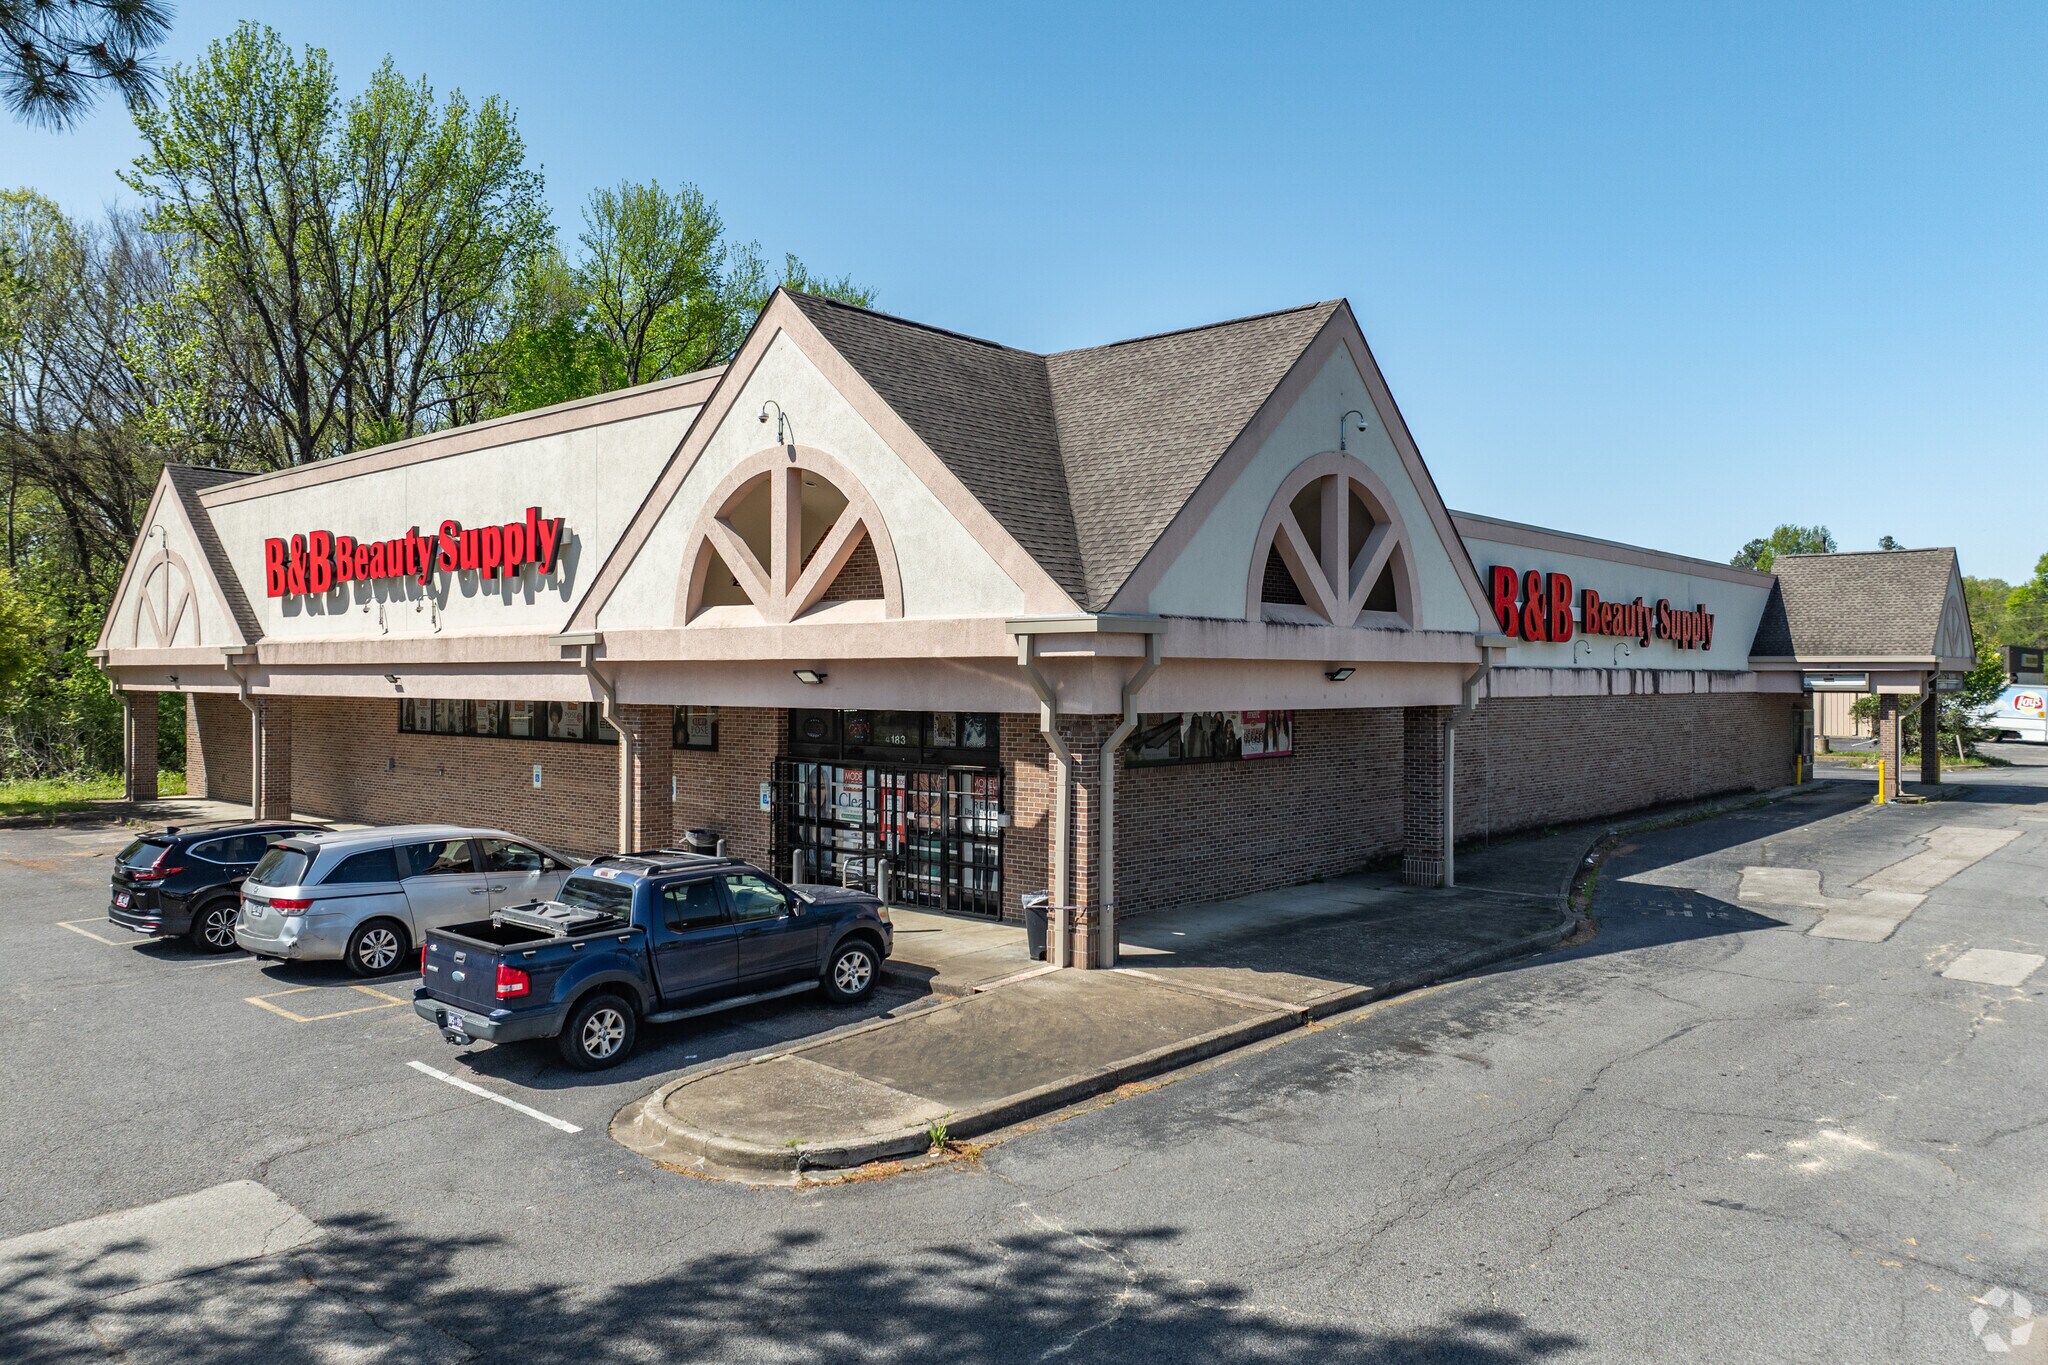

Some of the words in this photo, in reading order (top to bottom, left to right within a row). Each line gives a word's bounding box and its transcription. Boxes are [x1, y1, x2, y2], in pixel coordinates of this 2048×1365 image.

[265, 530, 337, 598] B&B
[336, 526, 438, 586] Beauty
[439, 506, 566, 580] Supply
[1489, 565, 1574, 643] B&B
[1581, 589, 1655, 648] Beauty
[1656, 598, 1715, 651] Supply
[844, 771, 863, 781] MODE
